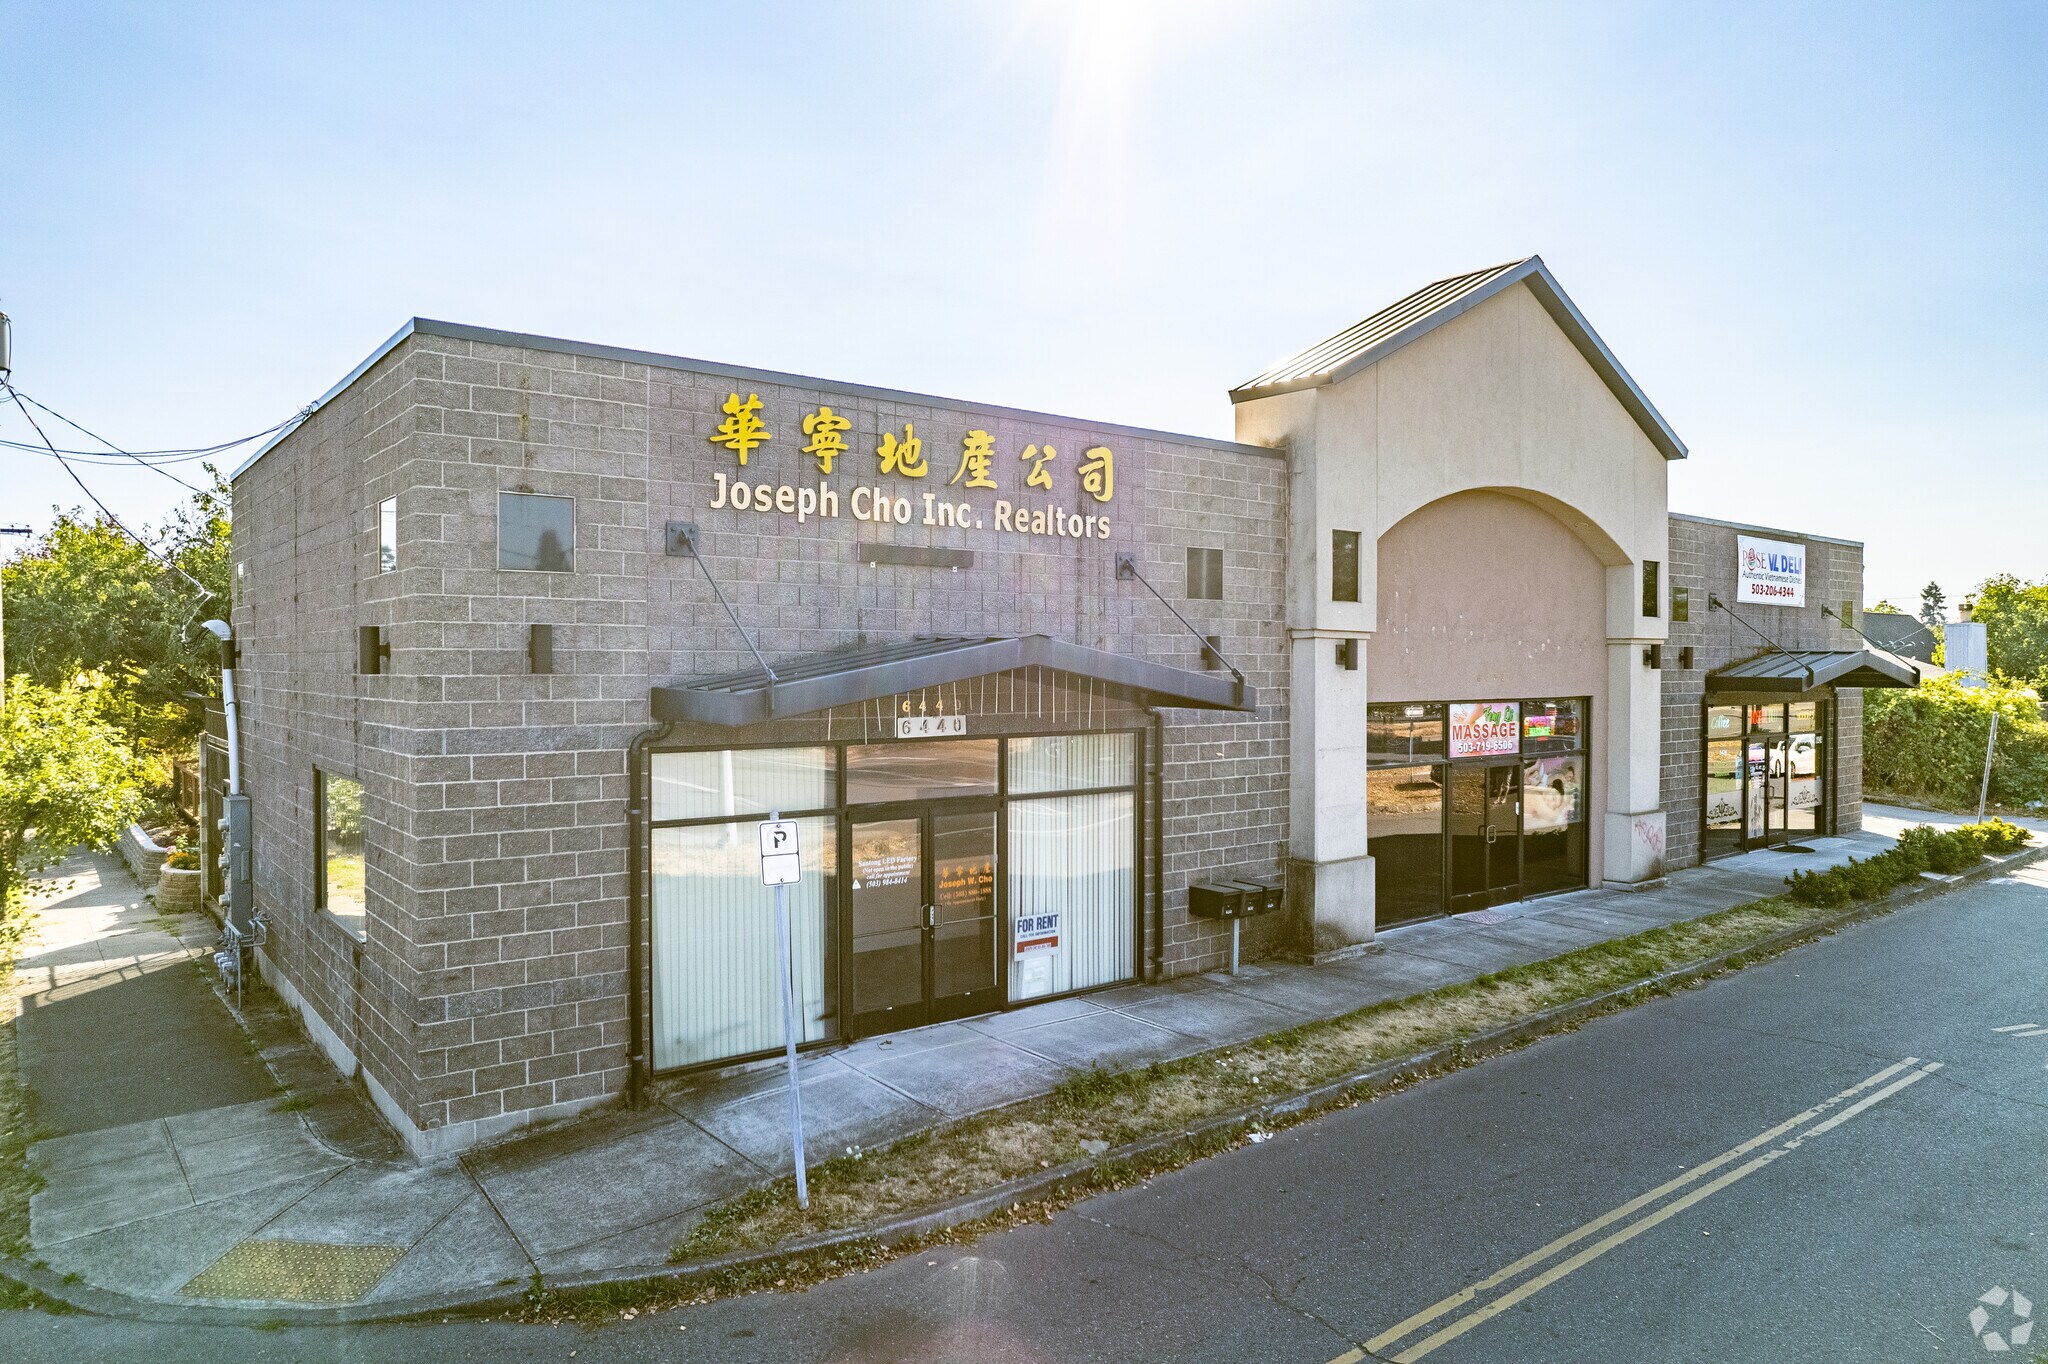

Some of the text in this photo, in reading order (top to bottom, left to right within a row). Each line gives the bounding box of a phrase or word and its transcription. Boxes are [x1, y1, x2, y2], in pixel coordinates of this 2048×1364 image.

[710, 473, 1111, 539] Joseph Cho Inc. Realtors
[1768, 553, 1779, 572] VL
[1781, 555, 1802, 574] DELI
[1742, 570, 1764, 580] Authentic
[1765, 573, 1789, 583] Vietnamese
[1751, 584, 1794, 597] 503-206-4344
[902, 718, 961, 735] 6440
[1452, 723, 1516, 740] MASSAGE
[1458, 740, 1513, 753] 503-719-6506
[883, 857, 895, 865] LED
[883, 870, 910, 878] appointment
[939, 875, 993, 888] Joseph W. Cho
[1017, 914, 1058, 933] FOR RENT
